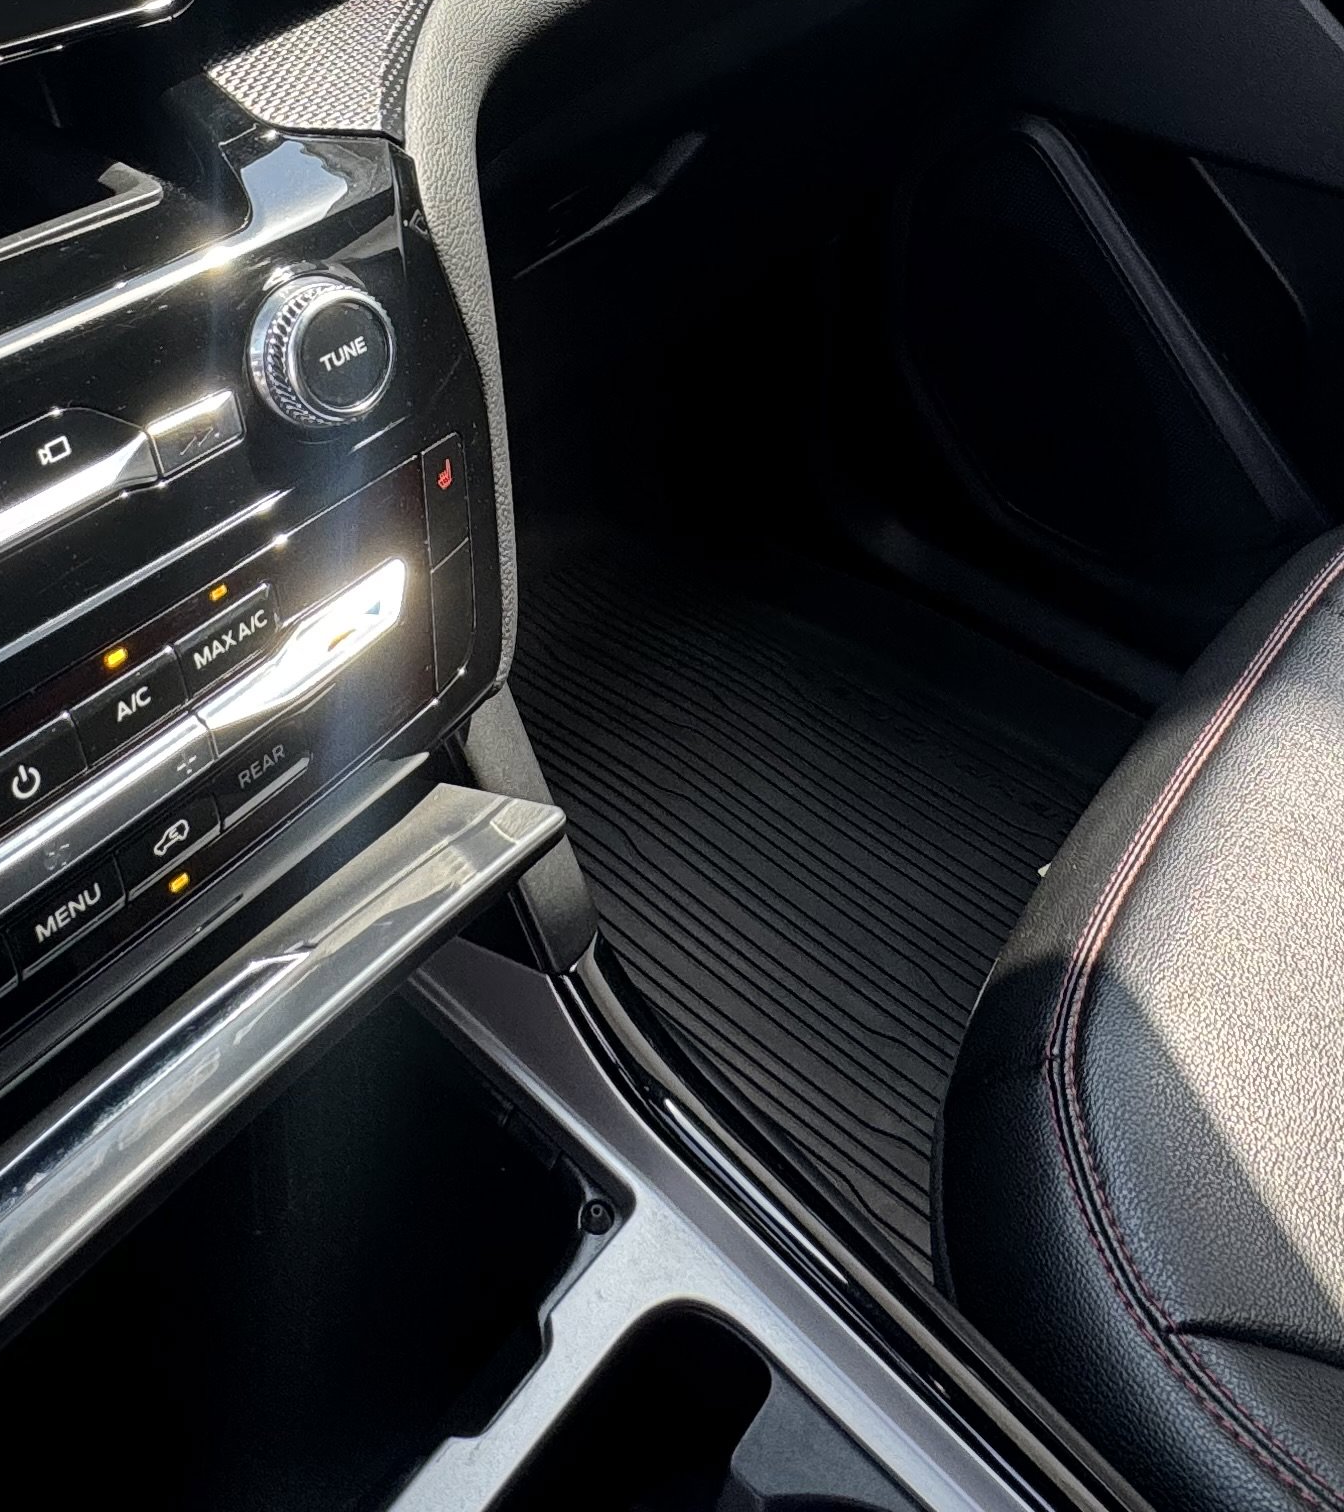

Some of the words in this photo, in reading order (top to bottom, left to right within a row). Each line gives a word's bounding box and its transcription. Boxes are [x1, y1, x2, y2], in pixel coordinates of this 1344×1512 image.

[320, 336, 368, 372] TUNE
[193, 629, 237, 669] MAX
[237, 609, 268, 642] A/C
[116, 686, 152, 722] A/C
[238, 744, 285, 788] REAR
[35, 882, 102, 943] MENU
